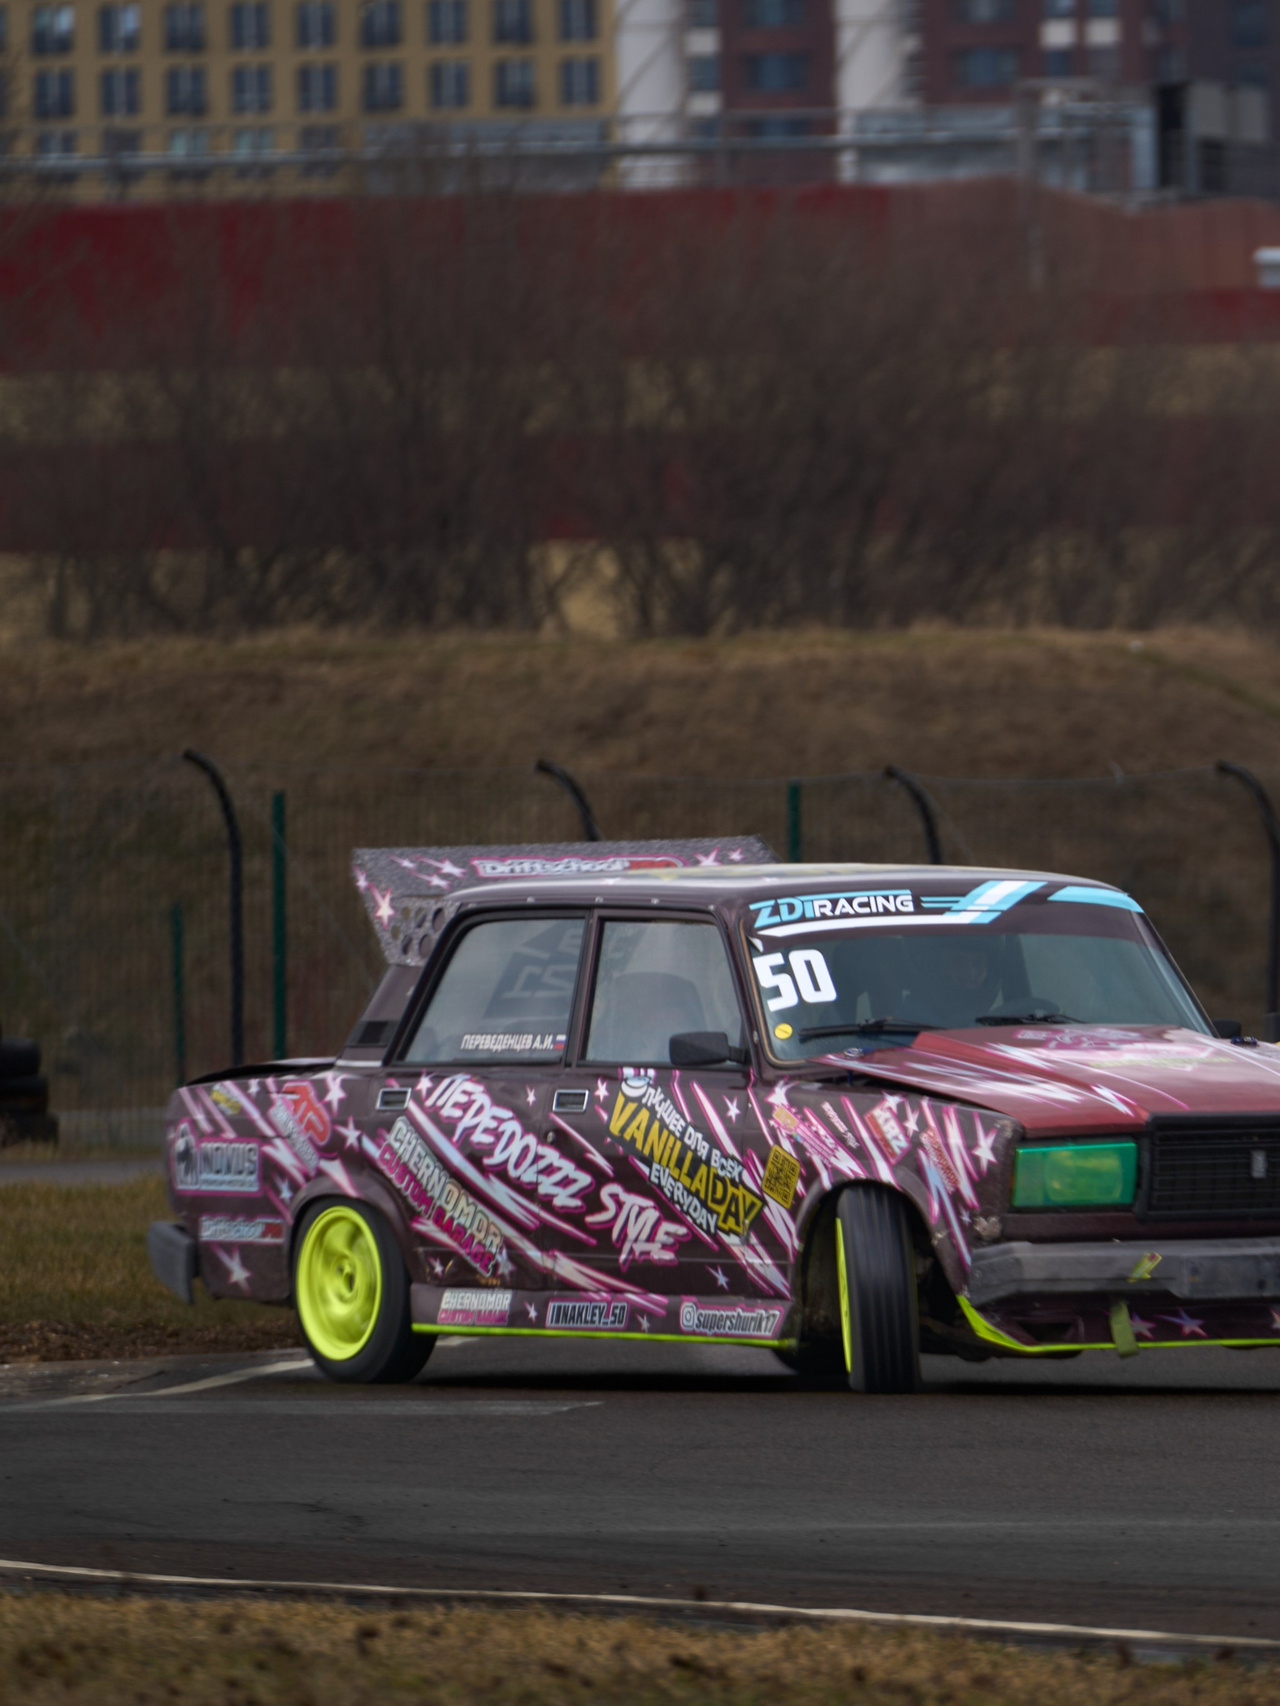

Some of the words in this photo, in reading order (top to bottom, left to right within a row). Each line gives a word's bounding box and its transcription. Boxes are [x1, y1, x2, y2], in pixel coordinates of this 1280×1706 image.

[813, 894, 914, 918] RACING
[753, 949, 837, 1011] 50
[461, 1034, 533, 1052] ПЕРЕВЕДЕНЦЕВ
[389, 1117, 502, 1250] CHERNOMOR
[710, 1148, 745, 1182] ВСЕХ
[378, 1148, 432, 1215] CUSTOM
[431, 1205, 495, 1275] GARAGE
[586, 1185, 689, 1265] STYLE
[650, 1162, 718, 1233] EVERYDAY
[440, 1291, 512, 1310] CHERNOMOR
